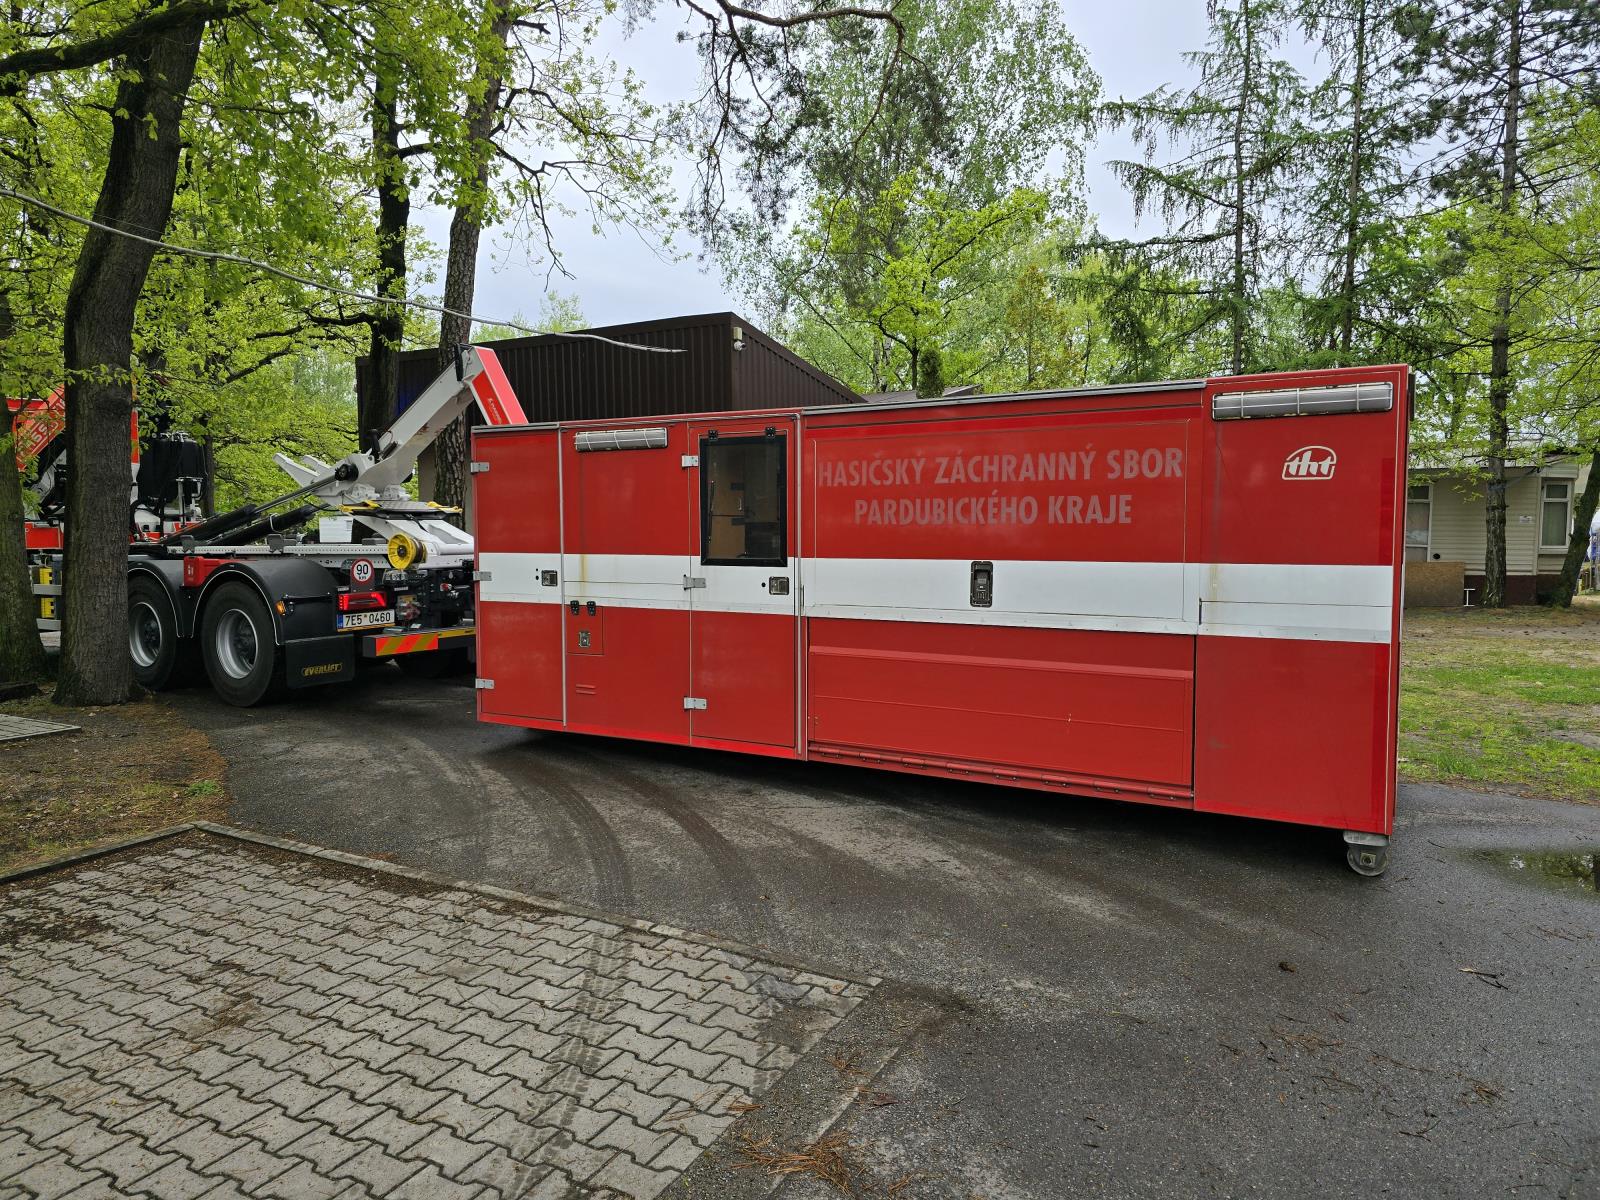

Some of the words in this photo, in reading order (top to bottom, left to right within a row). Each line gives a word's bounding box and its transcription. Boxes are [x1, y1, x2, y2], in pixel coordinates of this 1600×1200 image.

[818, 448, 926, 487] HASIČSKÝ
[934, 443, 1097, 485] ZÁCHRANNÝ
[1107, 447, 1184, 480] SBOR
[1285, 449, 1333, 476] tht
[854, 489, 1038, 526] PARDUBICKÉHO
[1047, 494, 1132, 525] KRAJE
[356, 563, 369, 575] 90
[345, 614, 362, 626] 7E5
[368, 612, 391, 624] 0460
